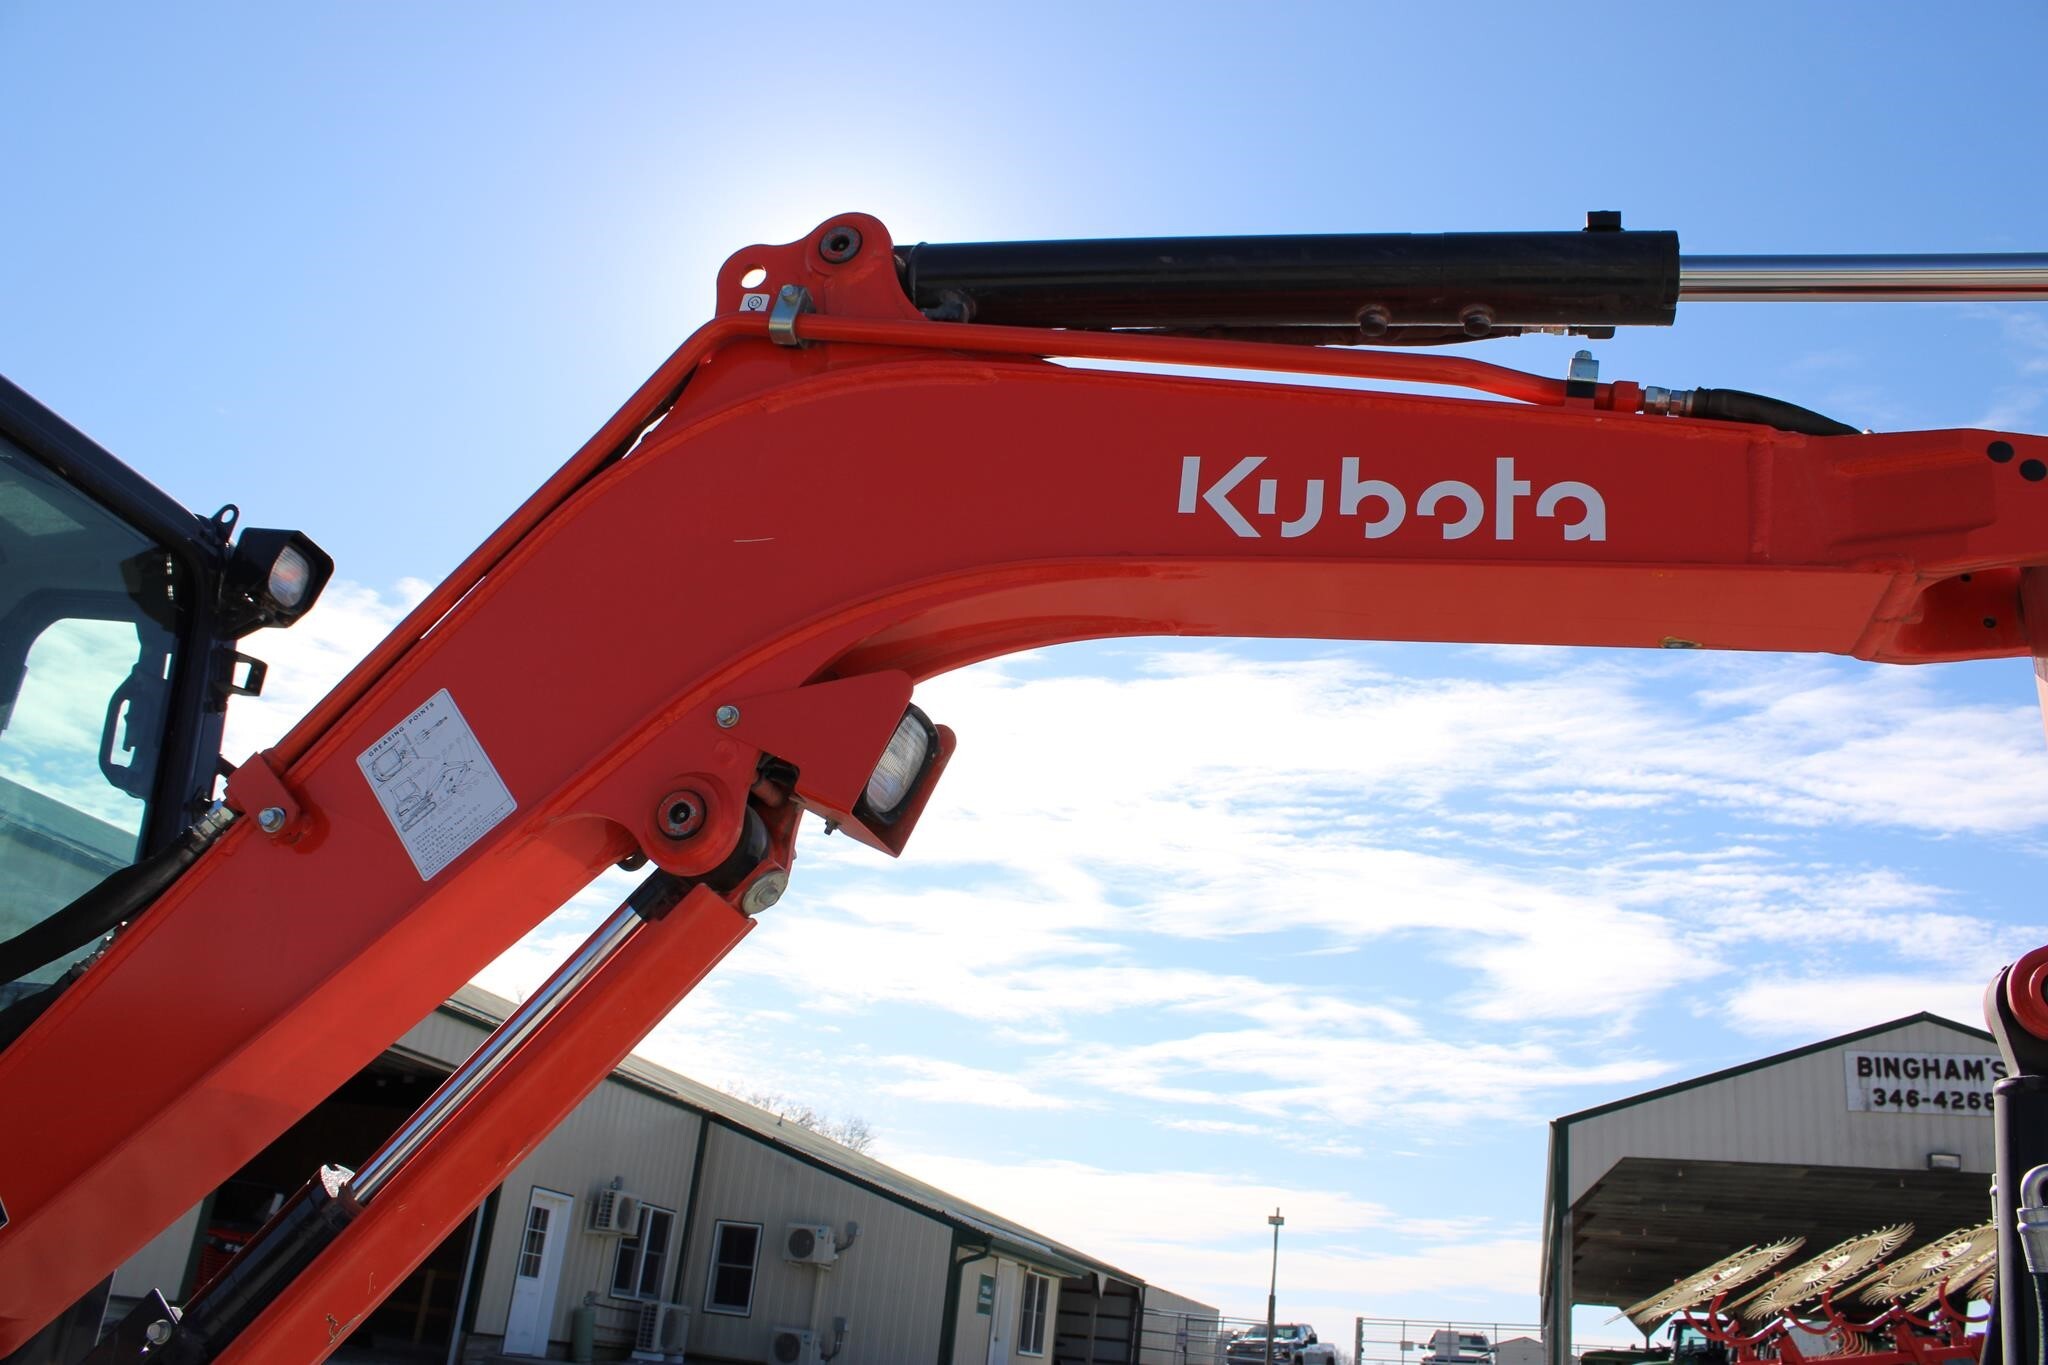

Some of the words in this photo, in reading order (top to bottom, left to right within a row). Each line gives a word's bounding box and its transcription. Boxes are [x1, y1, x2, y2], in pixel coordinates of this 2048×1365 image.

[1178, 456, 1606, 541] Kubota
[368, 726, 405, 757] GREASING
[408, 702, 434, 725] POINTS
[1857, 1056, 2008, 1081] BINGHAM'S
[1873, 1088, 1994, 1110] 346-4268
